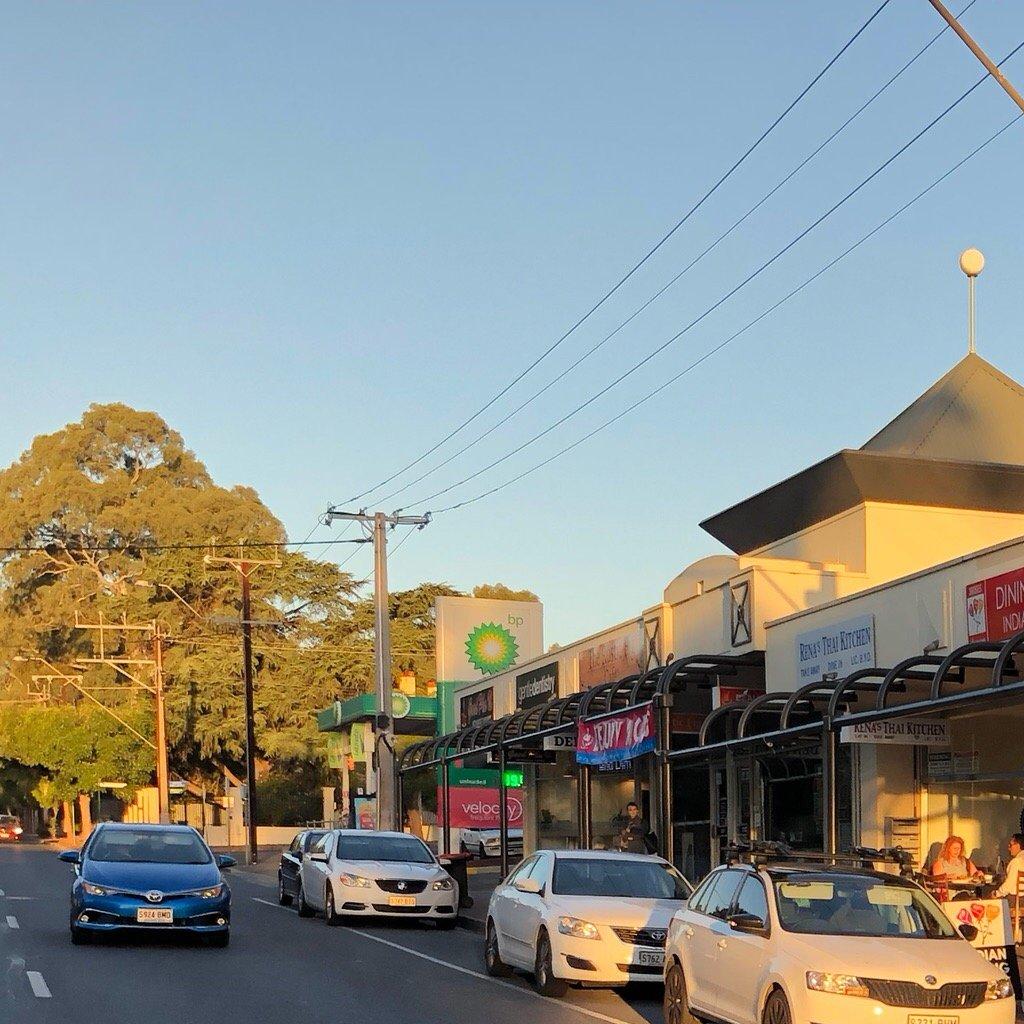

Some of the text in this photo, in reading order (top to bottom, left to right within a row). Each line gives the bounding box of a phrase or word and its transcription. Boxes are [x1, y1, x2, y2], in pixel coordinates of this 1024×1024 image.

[508, 614, 524, 629] bp
[822, 636, 839, 656] THAI
[840, 626, 871, 652] KITCHEN
[883, 721, 905, 735] THAI
[906, 722, 946, 736] KITCHEN
[461, 801, 517, 821] velocy
